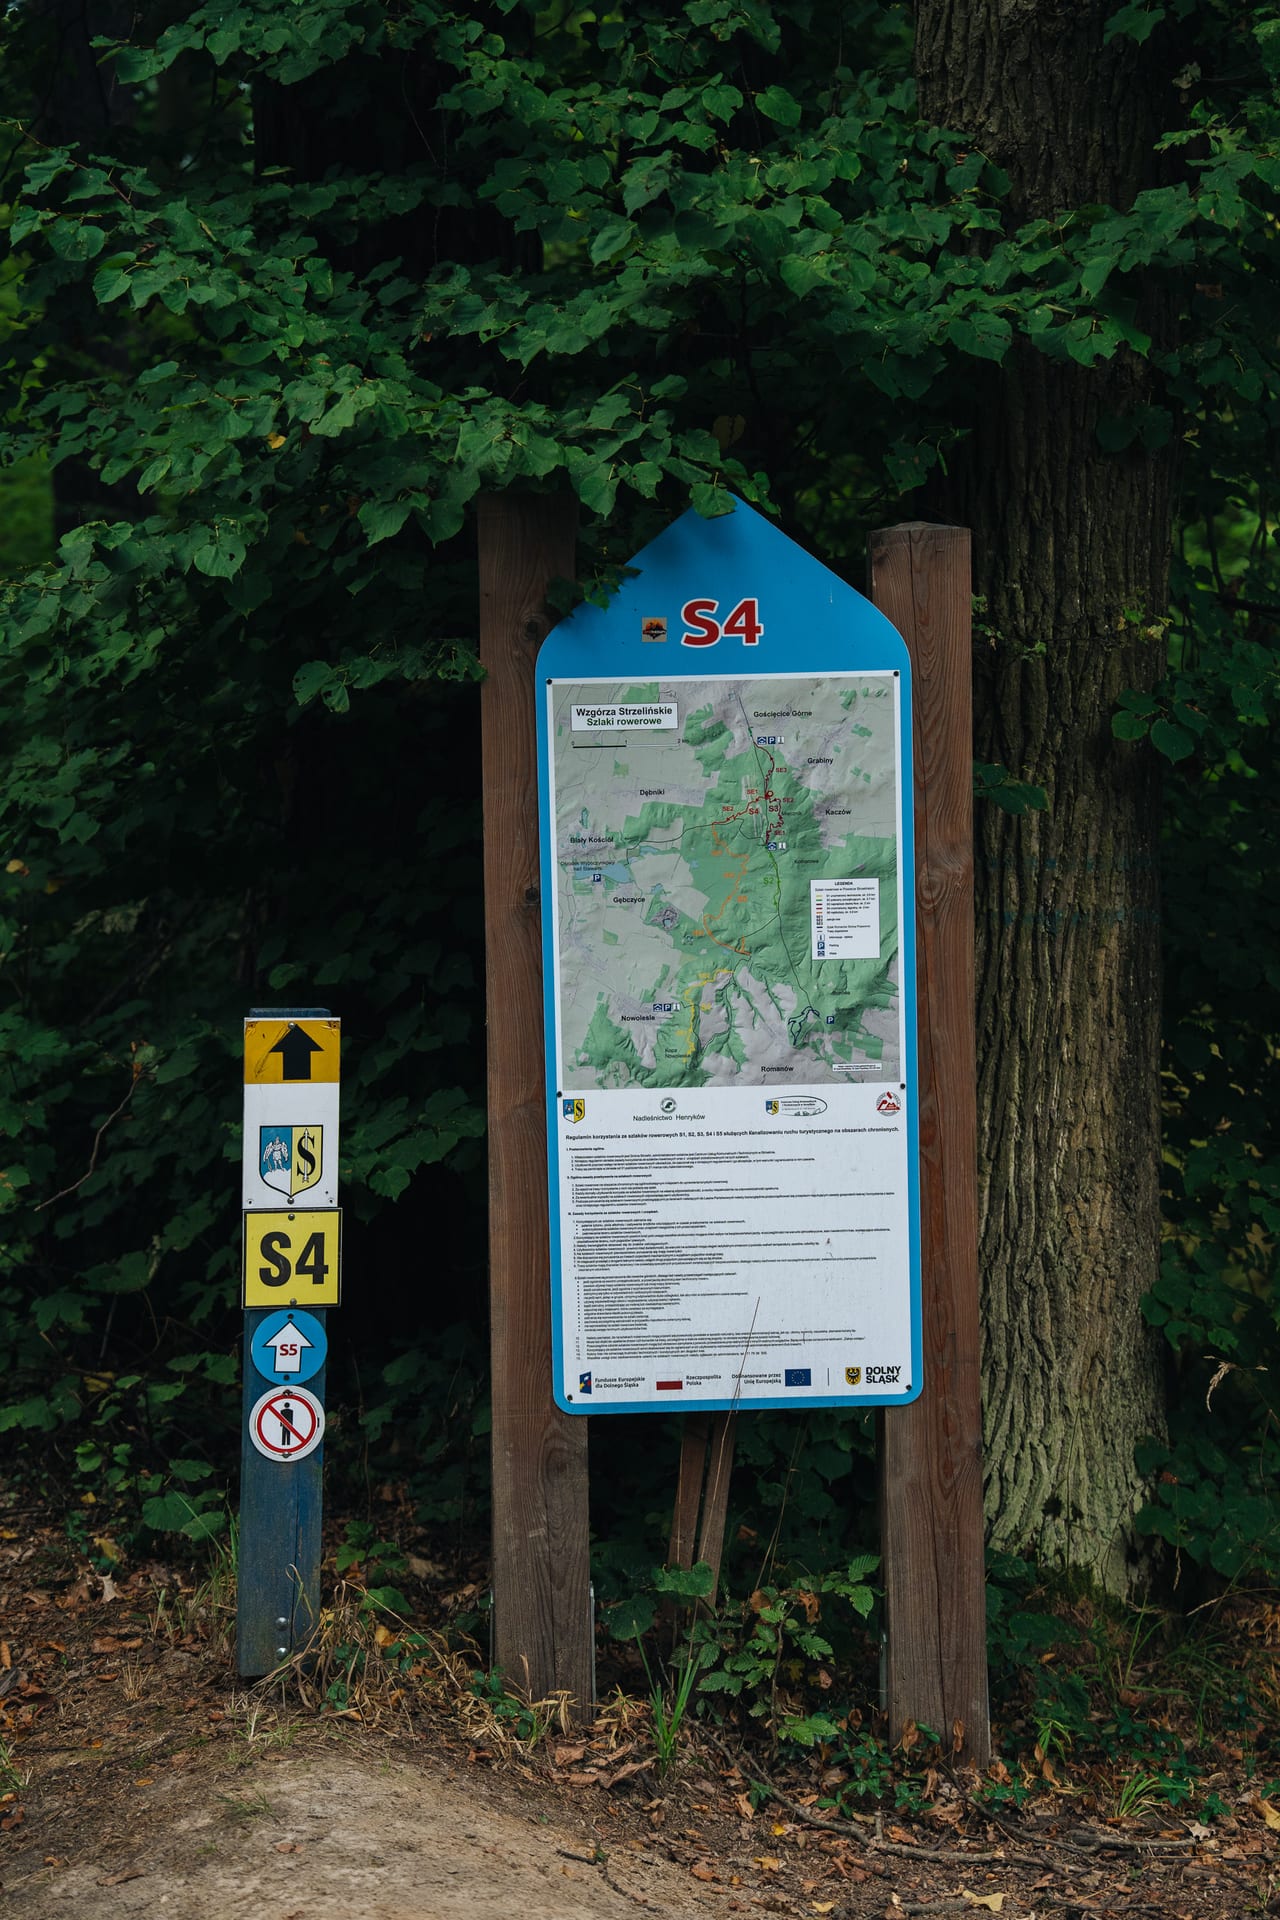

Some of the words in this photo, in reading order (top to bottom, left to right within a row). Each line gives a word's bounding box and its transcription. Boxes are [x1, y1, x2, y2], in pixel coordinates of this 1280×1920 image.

[681, 598, 764, 648] S4
[576, 707, 616, 718] Wzgórza
[618, 705, 672, 716] Strzelińskie
[753, 711, 790, 719] Gościęcice
[587, 717, 614, 726] Szlaki
[616, 717, 662, 726] rowerowe
[807, 757, 834, 765] Grabiny
[639, 789, 665, 797] Dębniki
[825, 808, 852, 816] Kaczów
[570, 837, 587, 845] Biały
[613, 896, 646, 904] Gębczyce
[633, 1114, 673, 1122] Nadleśnictwo
[675, 1113, 706, 1122] Henryków
[259, 1231, 329, 1287] S4
[279, 1344, 298, 1356] S5
[865, 1366, 901, 1376] DOLNY
[618, 1376, 645, 1384] Europejskie
[865, 1373, 899, 1385] ŚLĄSK
[603, 1382, 623, 1390] Dolnego
[623, 1381, 639, 1389] Śląska
